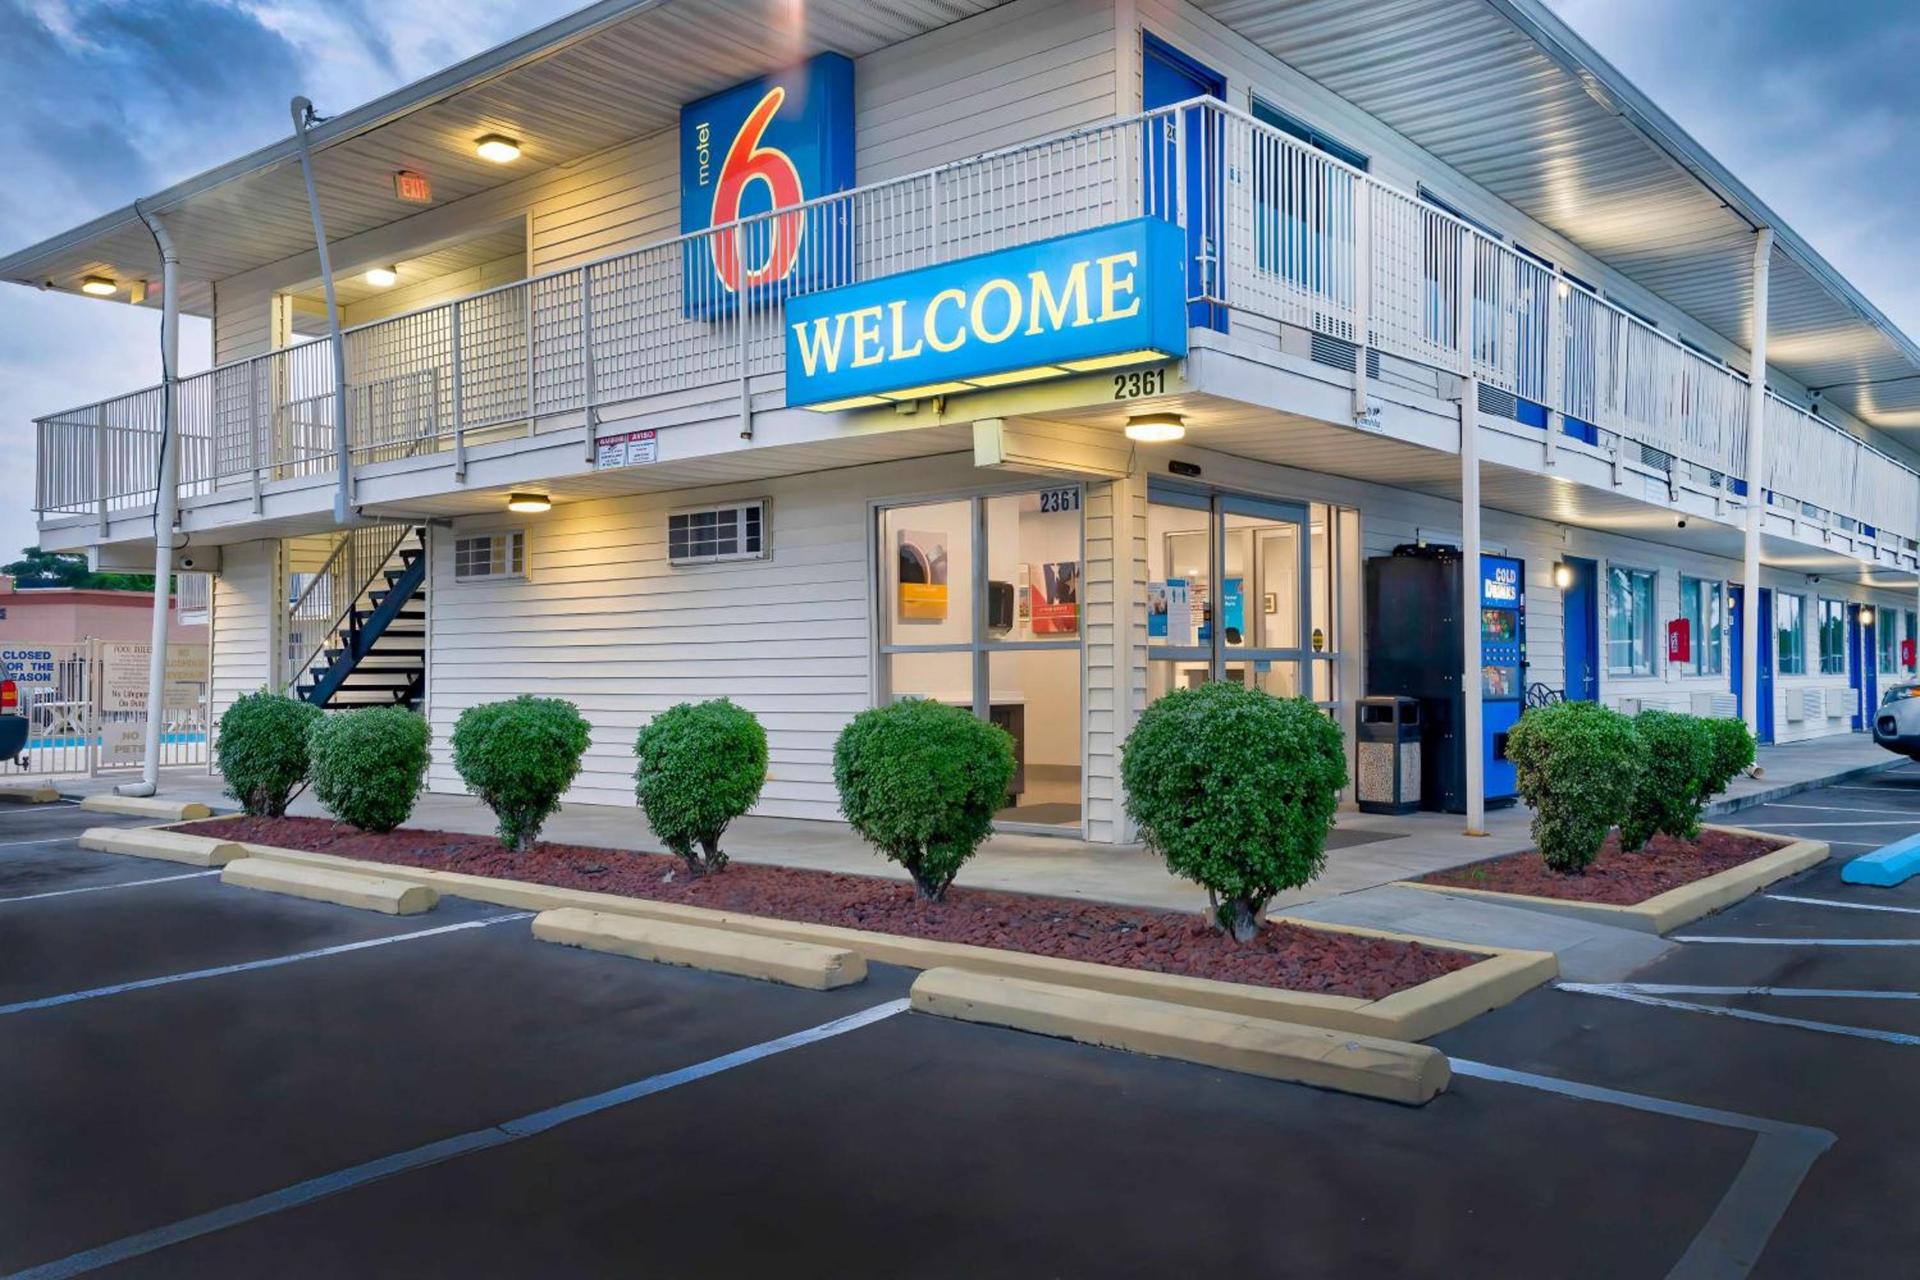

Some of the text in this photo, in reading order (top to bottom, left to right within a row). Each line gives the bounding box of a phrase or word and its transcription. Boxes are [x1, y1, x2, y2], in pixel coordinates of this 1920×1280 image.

[695, 122, 710, 186] motel
[401, 177, 428, 201] EXIT
[710, 86, 804, 293] 6
[792, 251, 1141, 377] WELCOME
[1114, 368, 1165, 400] 2361
[1040, 486, 1080, 513] 2361
[1495, 567, 1517, 584] COLD
[1484, 578, 1517, 601] DRINKS
[2, 650, 52, 660] CLOSED
[6, 662, 54, 671] OR THE
[10, 672, 52, 682] EASON
[122, 731, 140, 741] NO
